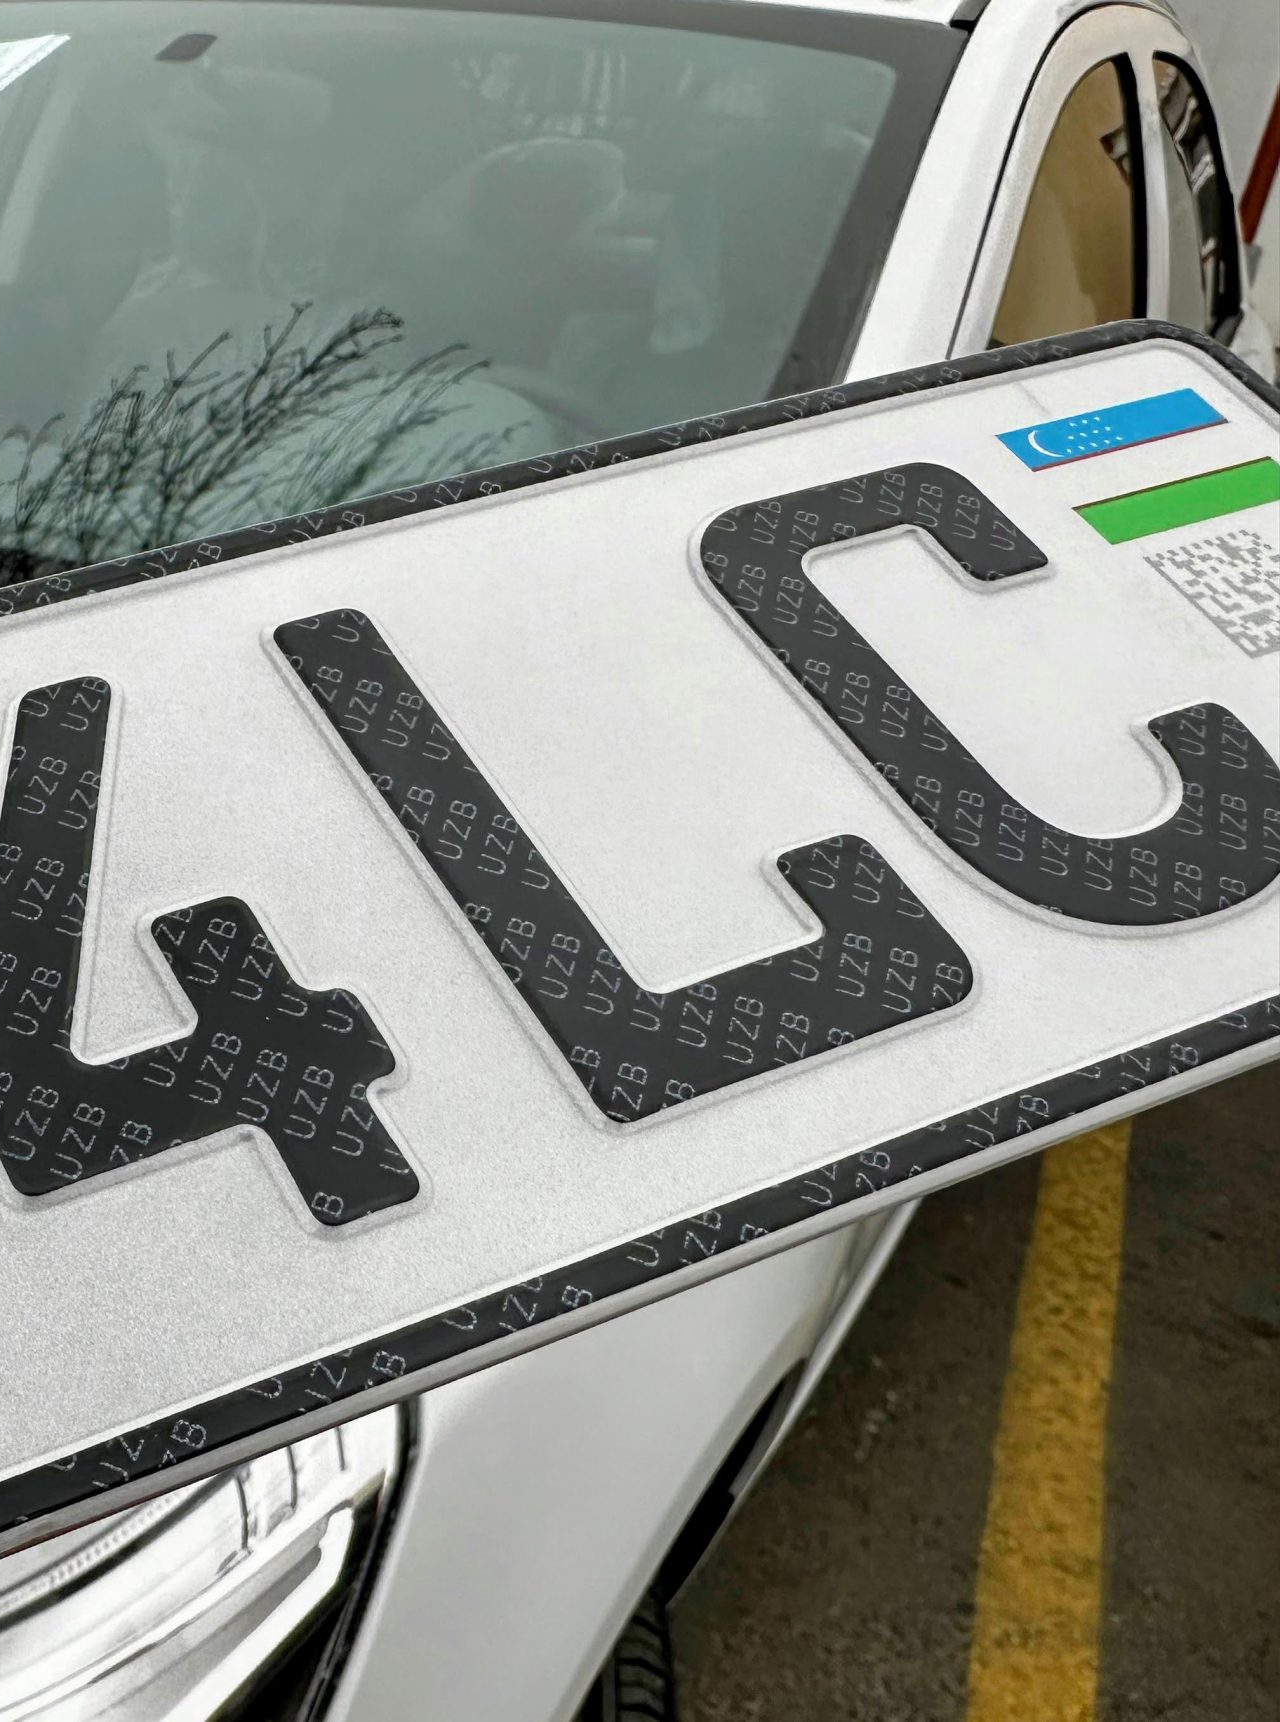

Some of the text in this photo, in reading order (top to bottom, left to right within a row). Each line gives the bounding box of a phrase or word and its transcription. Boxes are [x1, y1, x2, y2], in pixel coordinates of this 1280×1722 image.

[912, 483, 943, 528] UZB
[952, 494, 981, 540] UZB
[989, 520, 1018, 551] UZ
[735, 563, 767, 612] UZB
[772, 576, 806, 625] UZB
[812, 603, 840, 638] UZ
[311, 665, 344, 703] ZB
[801, 658, 831, 695] ZB
[837, 671, 871, 724] UZB
[339, 679, 384, 734] UZB
[380, 691, 424, 748] UZB
[879, 684, 912, 739] UZB
[920, 714, 949, 752] UZ
[16, 756, 68, 815] UZB
[399, 785, 436, 826] ZB
[911, 775, 942, 814] ZB
[433, 799, 478, 861] UZB
[476, 814, 519, 875] UZB
[951, 789, 985, 848] UZB
[995, 803, 1028, 862] UZB
[1218, 793, 1248, 851] UZB
[1039, 836, 1070, 877] UZ
[1128, 847, 1159, 907] UZB
[10, 857, 65, 921] UZB
[185, 917, 238, 985] UZB
[537, 932, 581, 1000] UZB
[834, 932, 873, 998] UZB
[880, 946, 919, 1014] UZB
[5, 966, 62, 1037] UZB
[676, 983, 718, 1049] UZB
[722, 995, 765, 1065] UZB
[774, 1011, 811, 1064] ZB
[188, 1032, 243, 1105] UZB
[236, 1048, 288, 1123] UZB
[0, 1085, 60, 1162] UZB
[282, 1065, 335, 1140] UZB
[331, 1104, 375, 1157] UZ
[49, 1102, 106, 1181] UZB
